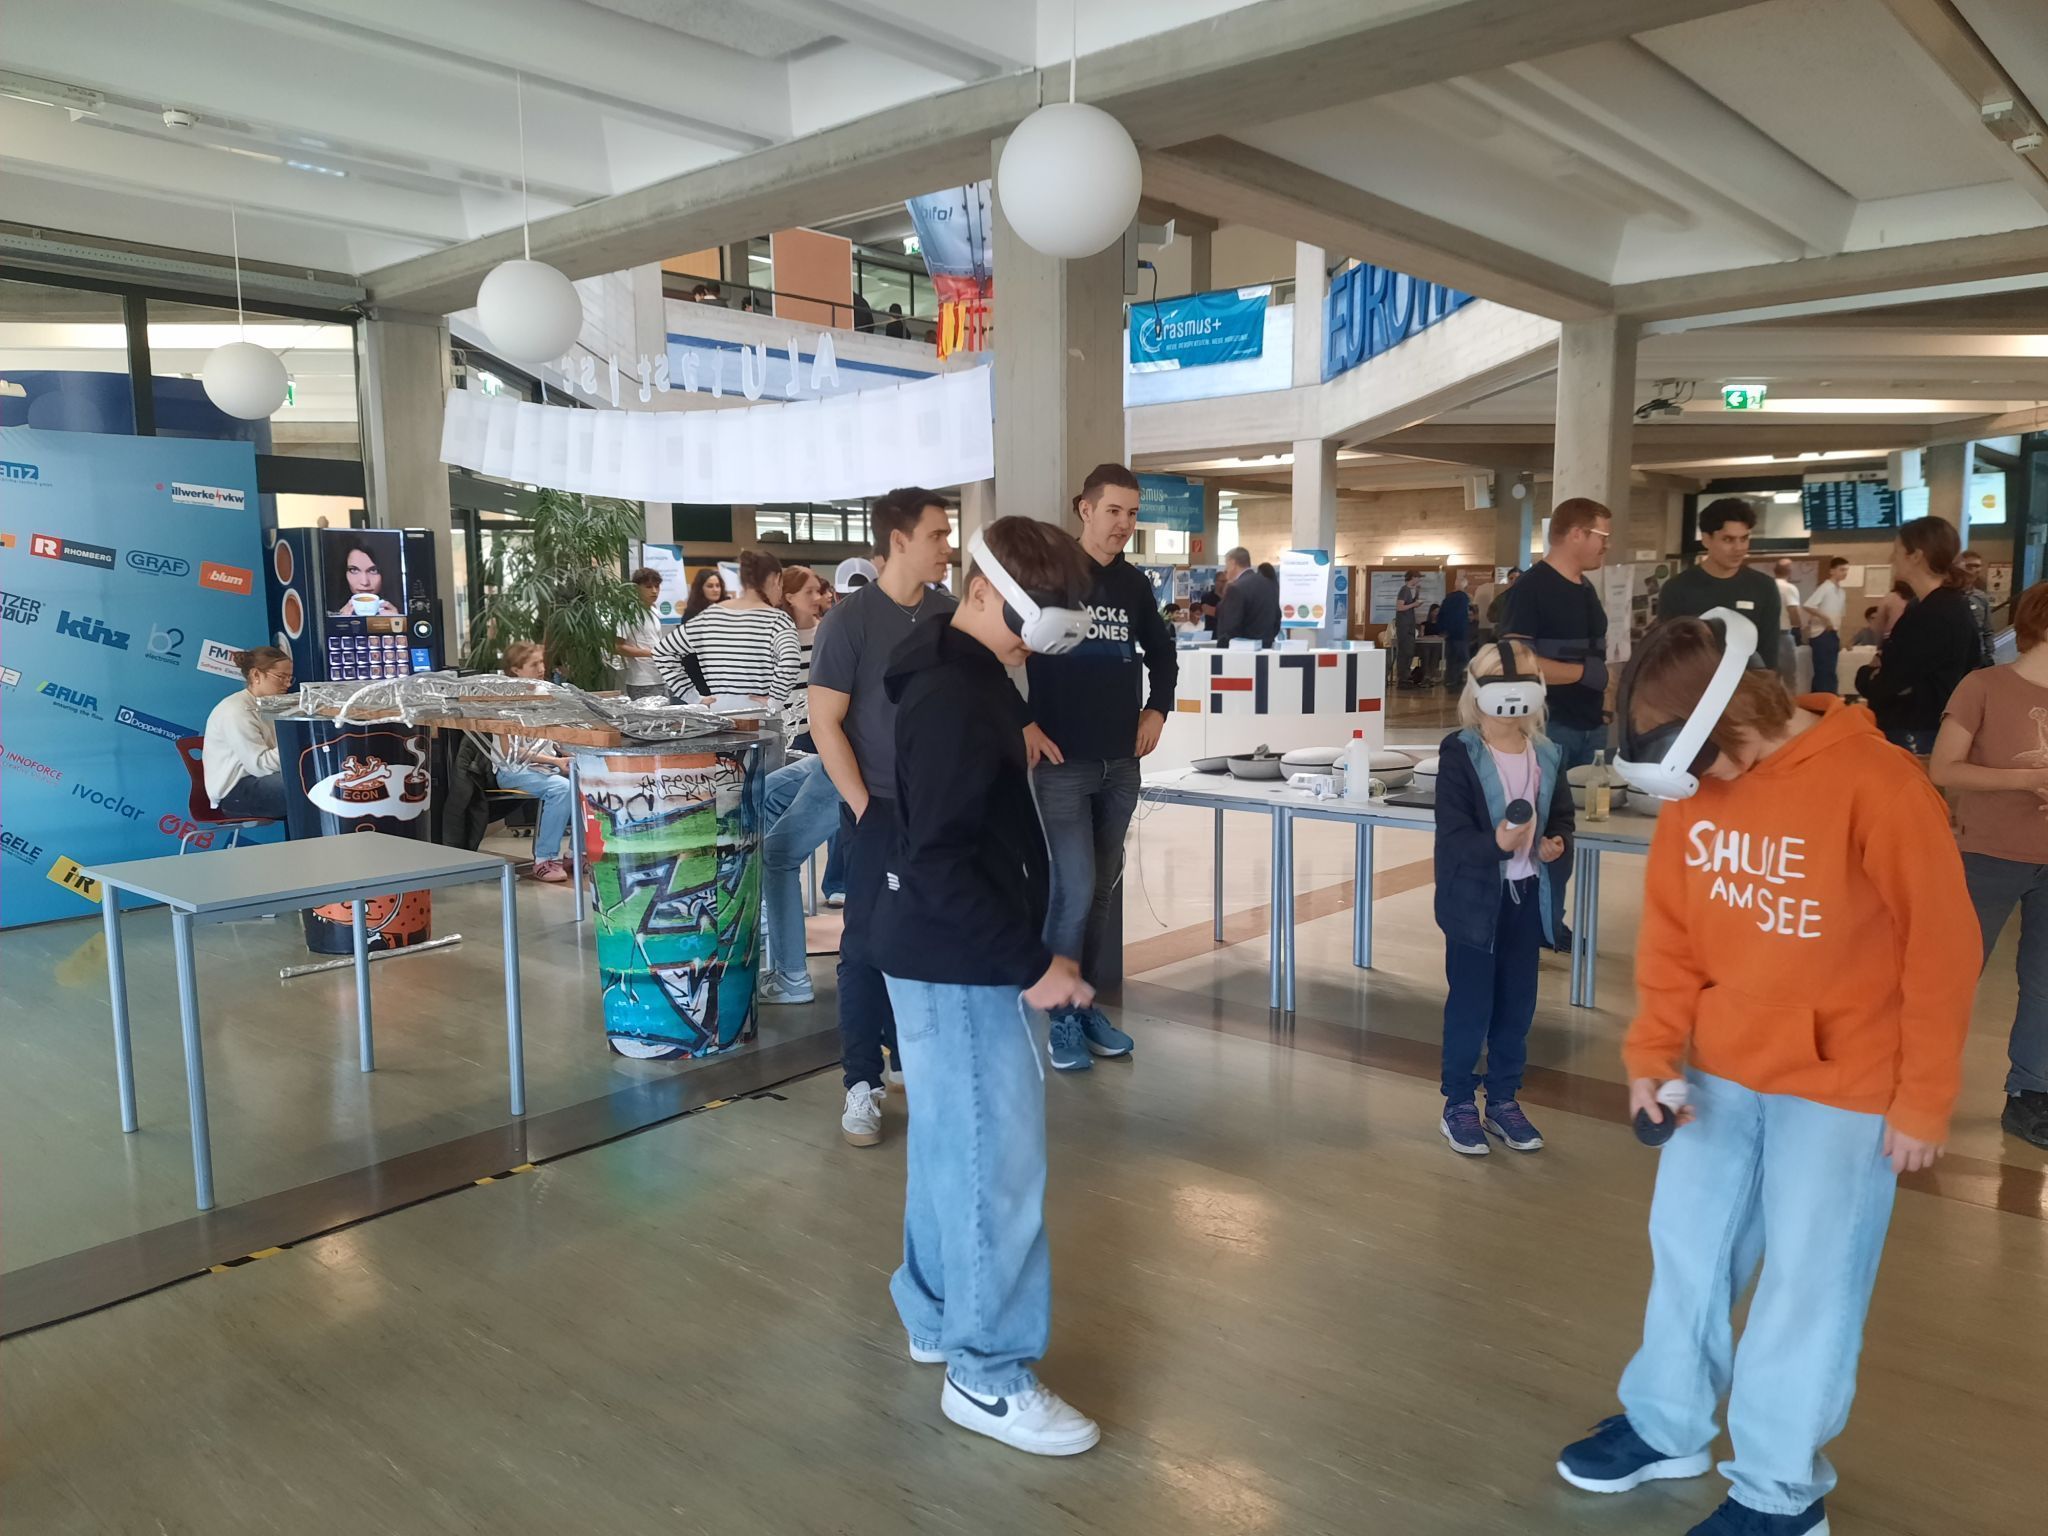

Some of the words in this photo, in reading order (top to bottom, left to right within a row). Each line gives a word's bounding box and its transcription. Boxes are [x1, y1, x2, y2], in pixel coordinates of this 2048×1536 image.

[172, 486, 215, 500] illwerke
[222, 493, 244, 503] vkw
[64, 547, 112, 562] RHOMBERG
[131, 553, 184, 572] GRAF
[209, 570, 243, 586] blum
[1087, 605, 1129, 623] ACK&
[56, 610, 130, 650] künz
[1086, 624, 1129, 641] ONES
[40, 682, 98, 712] BAUR
[6, 751, 64, 781] INNOFORCE
[342, 789, 379, 801] EGON
[0, 828, 43, 860] GELE
[1710, 876, 1754, 909] AM
[1756, 888, 1822, 938] SEE
